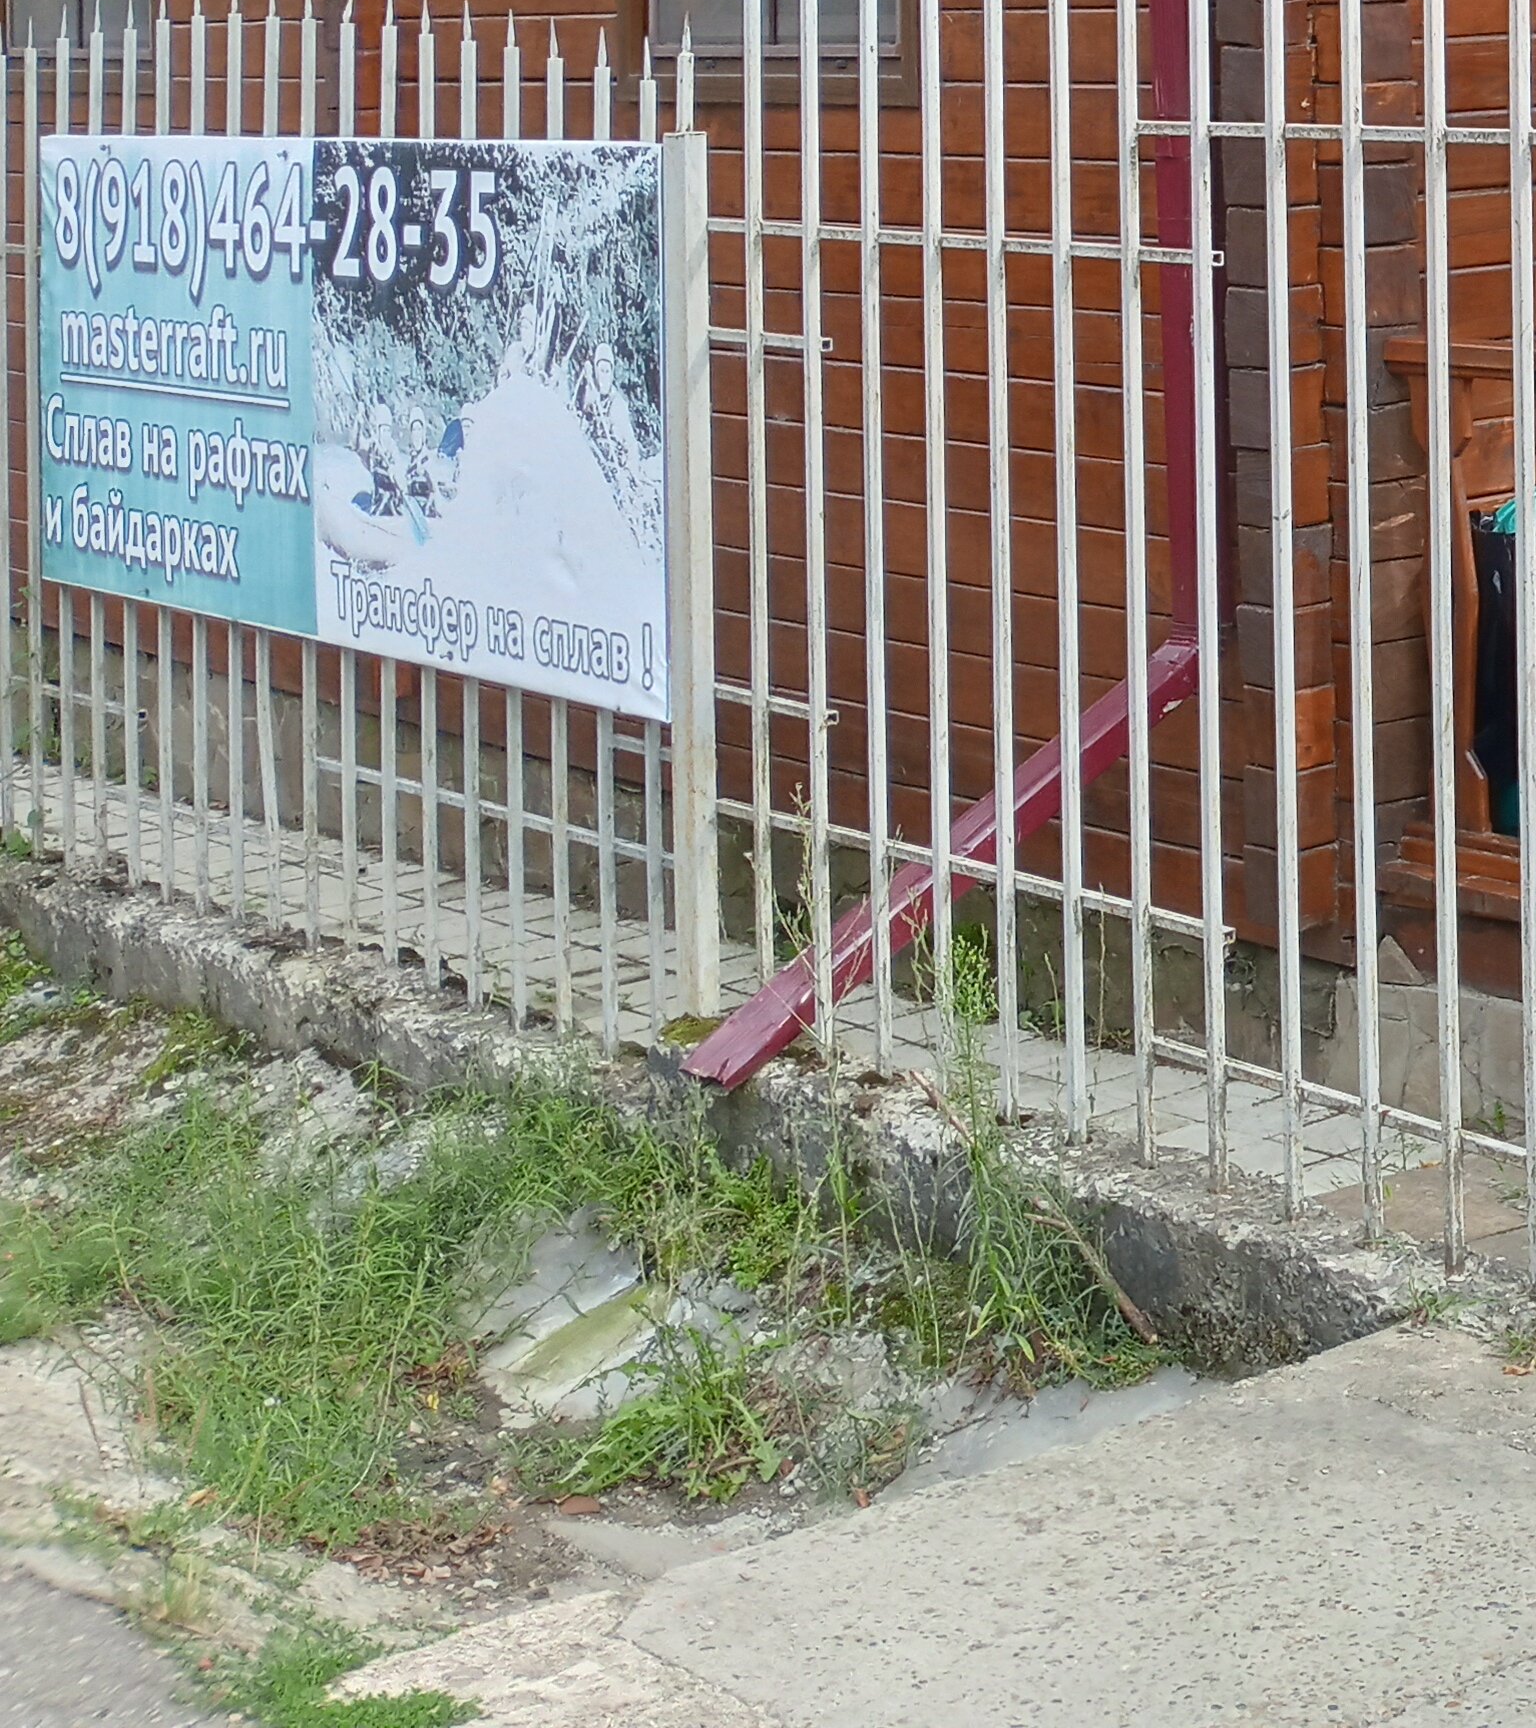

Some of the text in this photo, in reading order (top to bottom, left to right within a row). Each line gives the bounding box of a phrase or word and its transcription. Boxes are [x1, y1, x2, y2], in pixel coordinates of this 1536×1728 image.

[55, 158, 496, 303] 8(918)464-28-35
[61, 305, 287, 388] masterraft.ru
[46, 393, 310, 510] Сплав на рафтах
[46, 483, 240, 582] и байдарках
[331, 560, 478, 661] Трансфер
[487, 606, 524, 660] на
[533, 616, 630, 684] сплав
